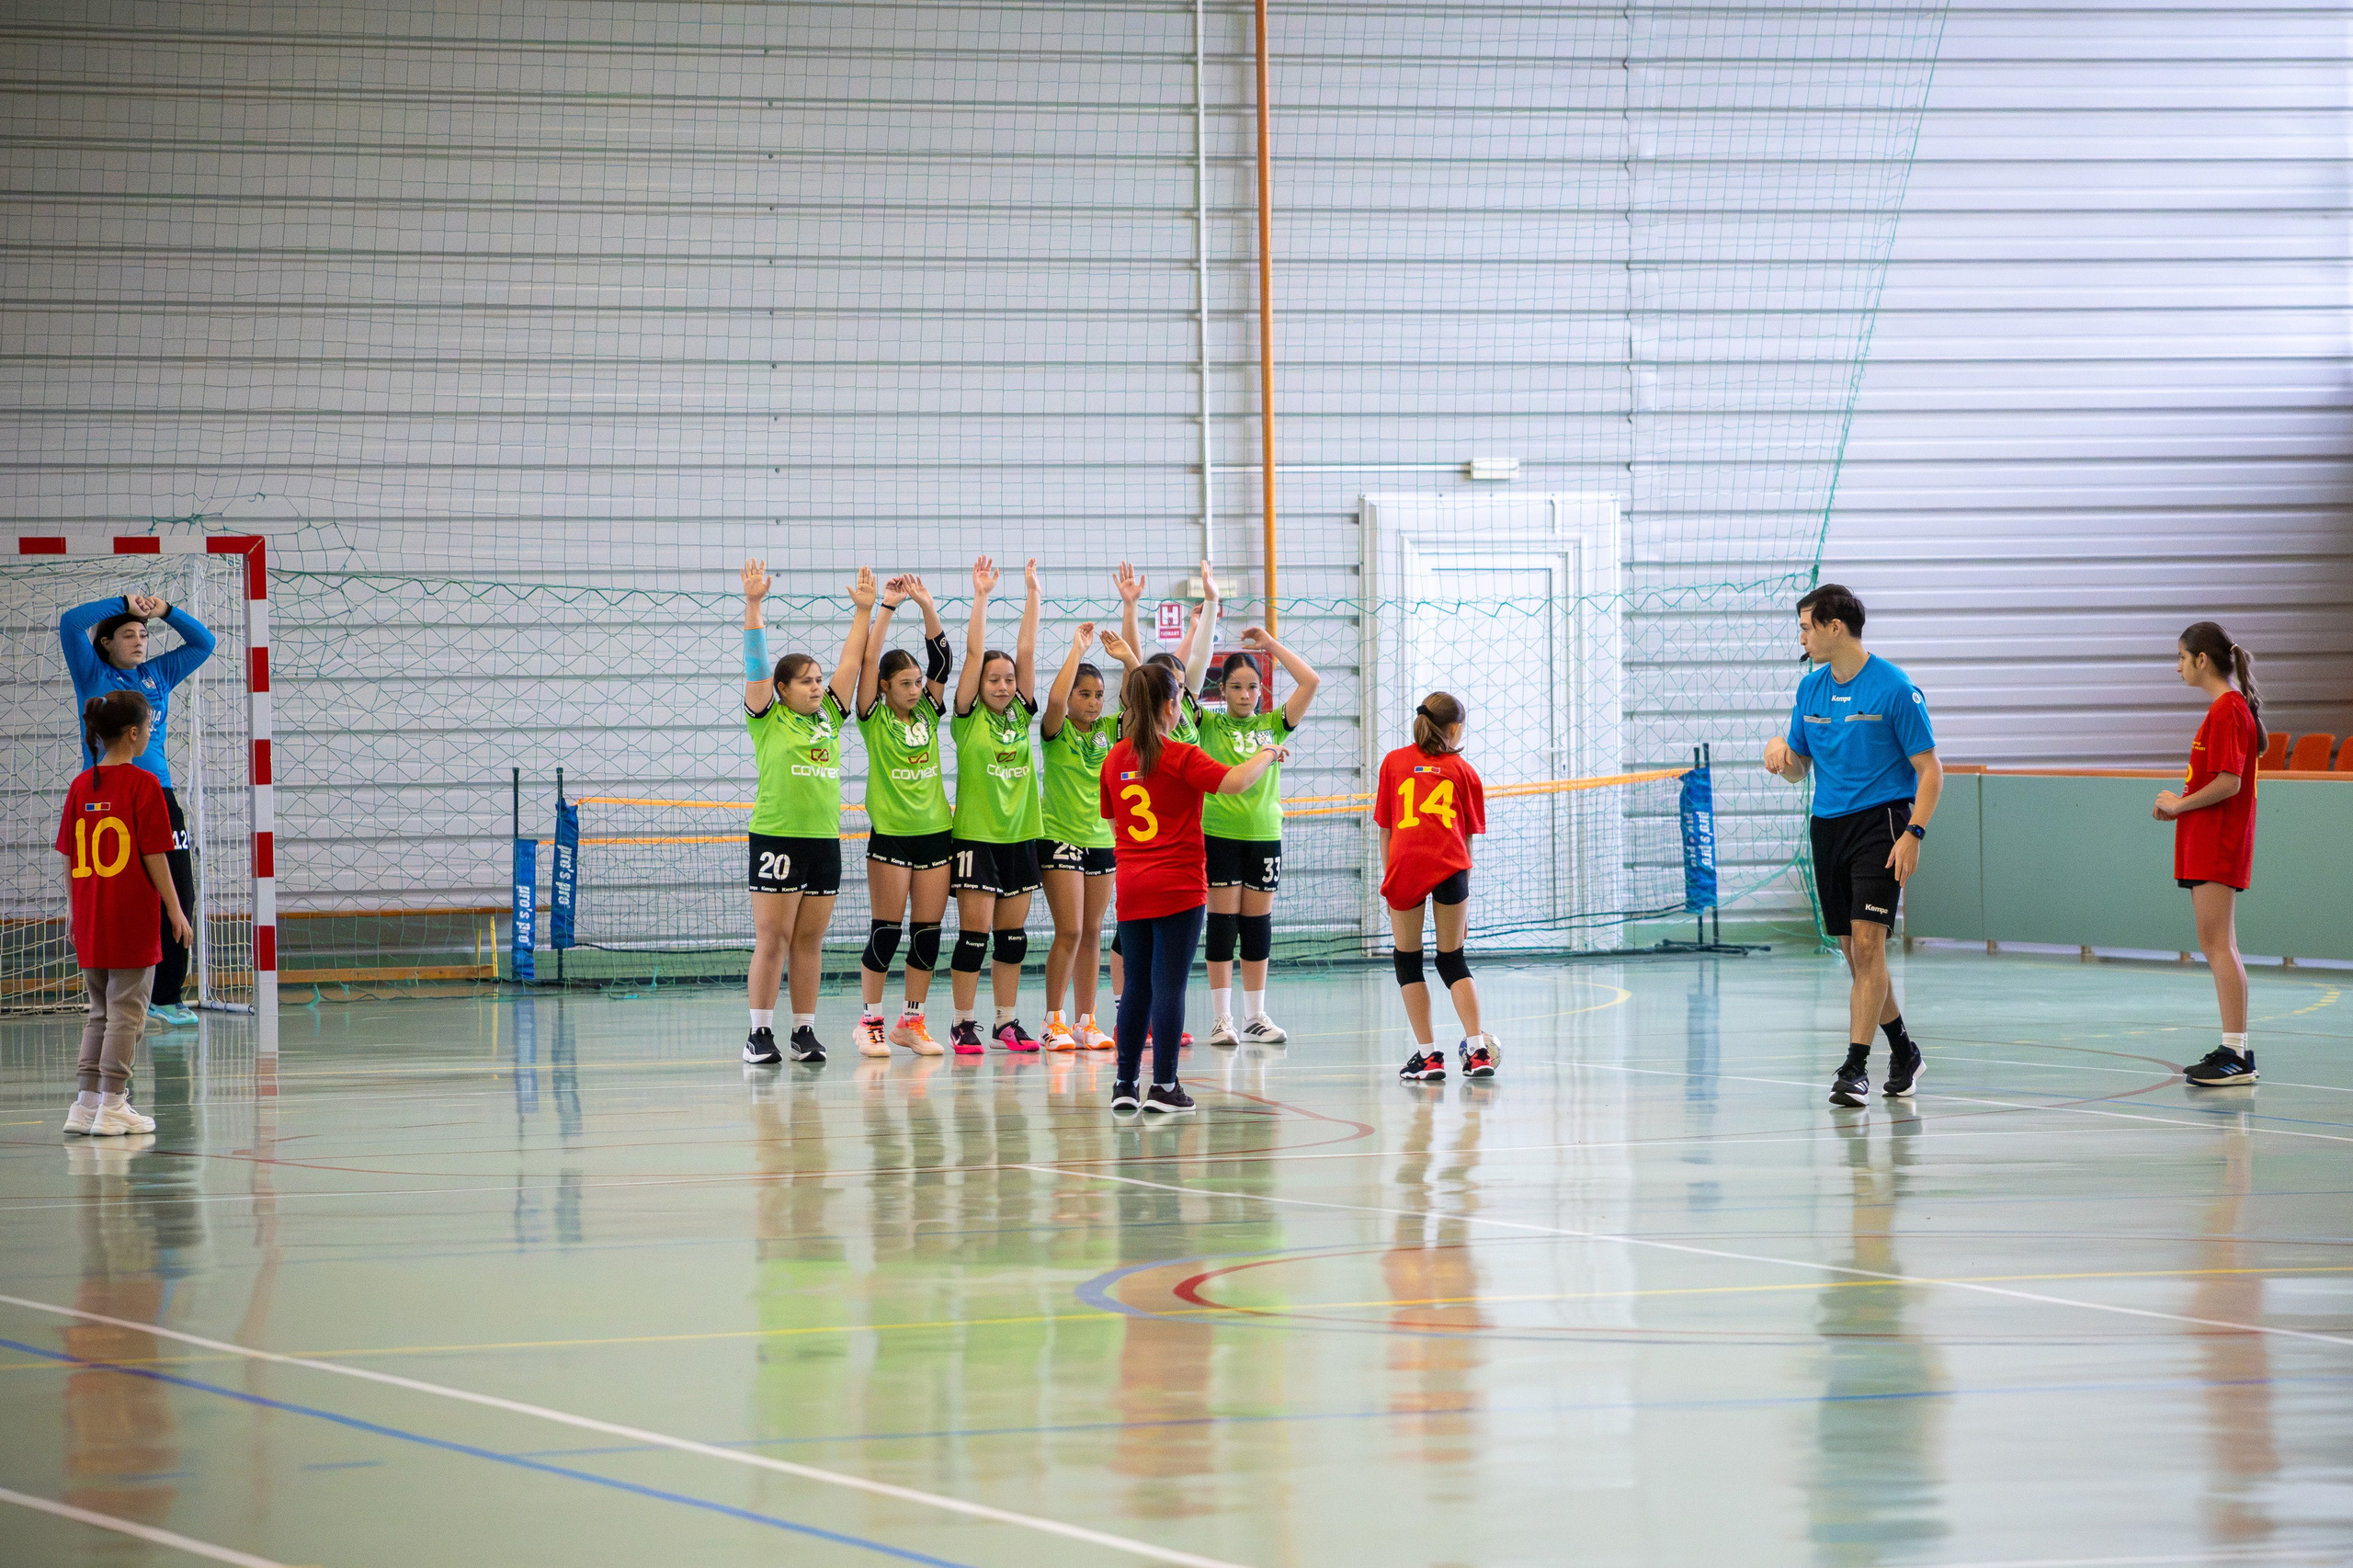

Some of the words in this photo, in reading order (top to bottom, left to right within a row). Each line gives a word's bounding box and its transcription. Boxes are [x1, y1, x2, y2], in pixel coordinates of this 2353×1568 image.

[1162, 606, 1179, 625] H
[1831, 695, 1852, 703] Kempa
[1120, 784, 1158, 842] 3
[1397, 777, 1457, 829] 14
[72, 816, 131, 878] 10
[172, 829, 189, 850] 12
[557, 845, 574, 880] pro's
[758, 851, 790, 880] 20
[957, 850, 973, 878] 11
[1698, 845, 1712, 866] pro
[1262, 856, 1281, 882] 33
[516, 884, 533, 919] pro's
[555, 881, 571, 905] pro
[1865, 903, 1889, 915] Kempa
[516, 921, 530, 943] pro
